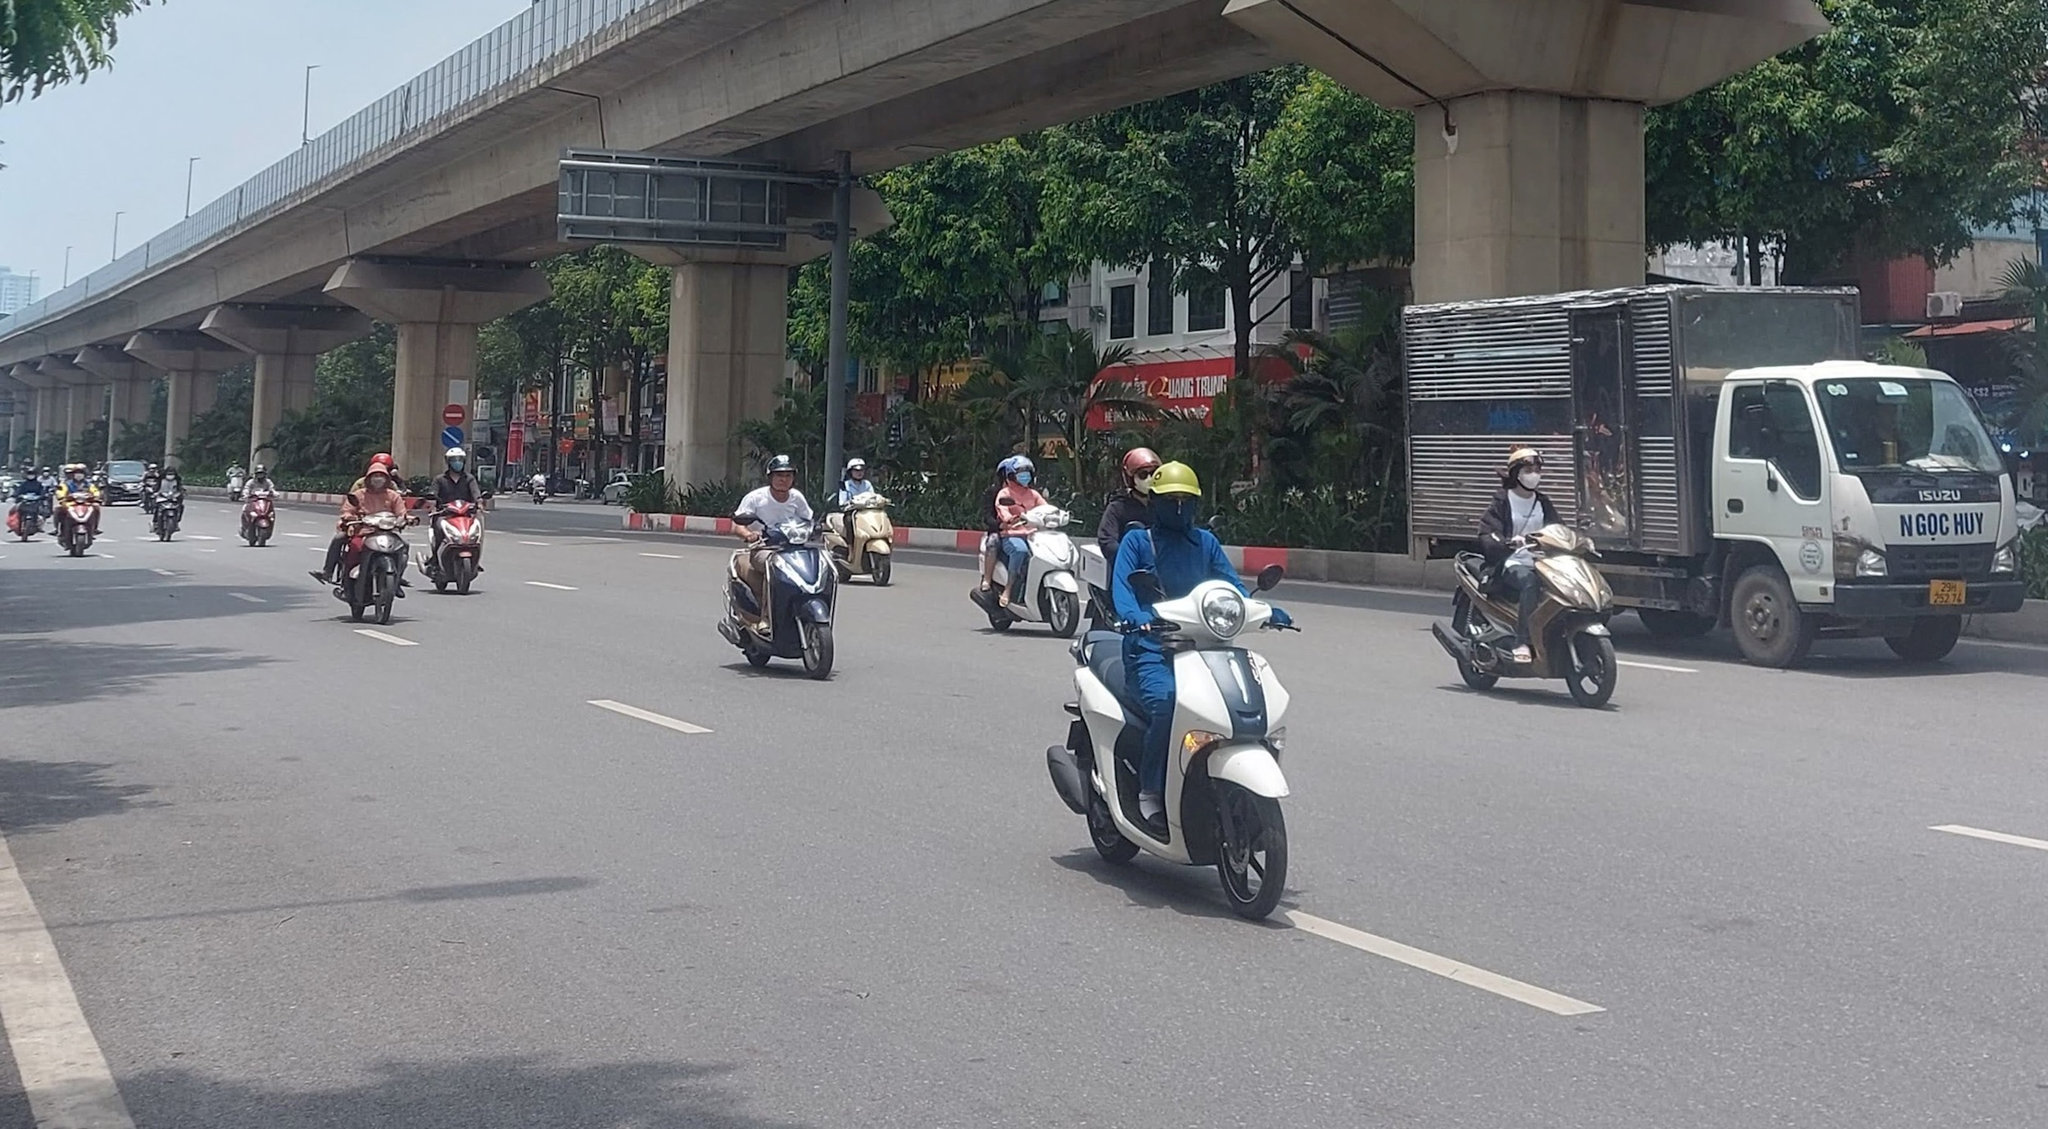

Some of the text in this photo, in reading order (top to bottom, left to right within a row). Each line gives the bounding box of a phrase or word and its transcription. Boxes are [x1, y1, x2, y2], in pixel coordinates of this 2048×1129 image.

[1147, 376, 1194, 399] QUANG
[1196, 375, 1227, 398] TRUNG
[1919, 490, 1961, 501] ISUZU
[1900, 512, 1984, 541] NGỌC HUY
